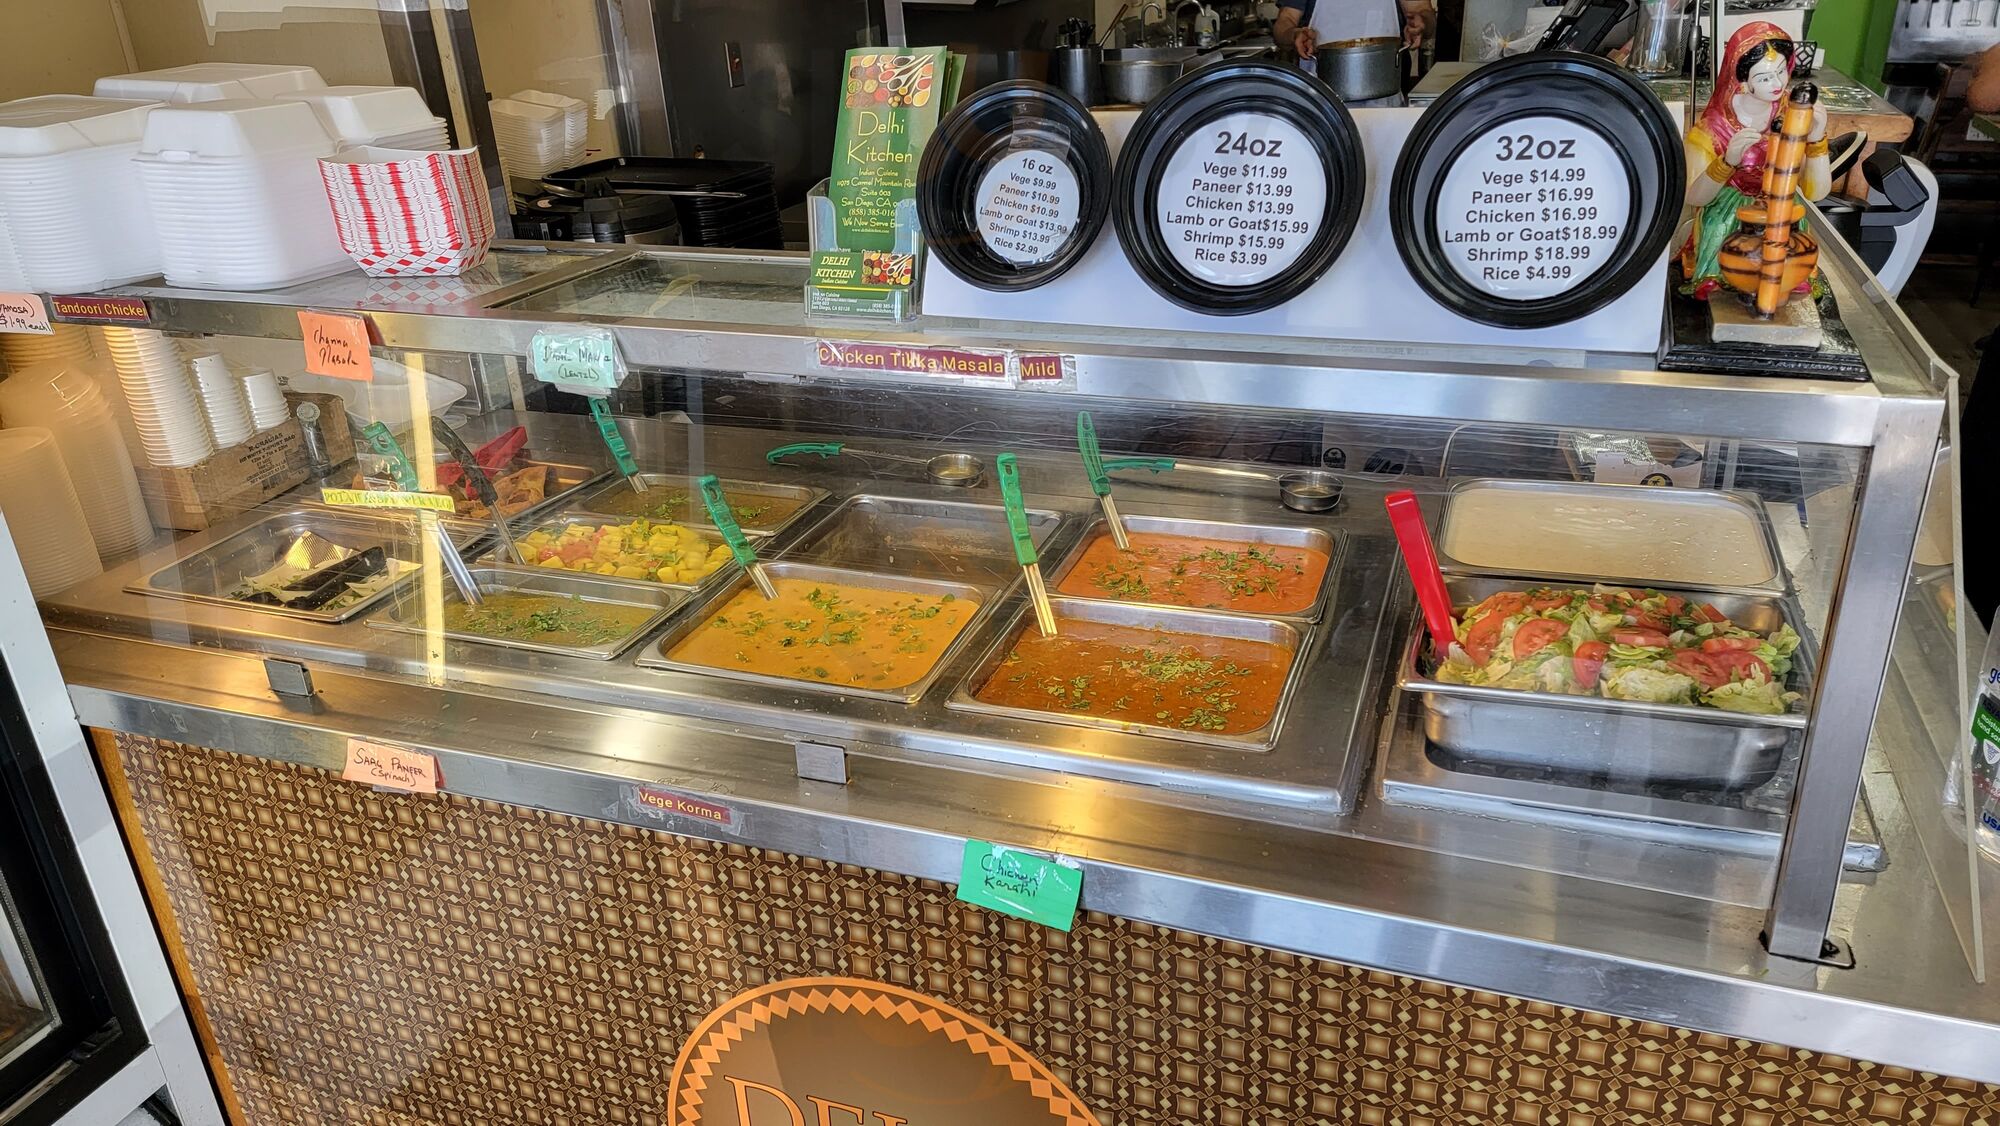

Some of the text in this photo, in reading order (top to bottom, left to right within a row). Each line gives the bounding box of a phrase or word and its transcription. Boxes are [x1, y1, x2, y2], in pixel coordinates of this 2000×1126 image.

[858, 111, 906, 136] Delhi
[847, 139, 913, 165] Kitchen
[1214, 131, 1283, 158] 24oz
[1495, 134, 1577, 162] 32oz
[1022, 158, 1054, 175] 16 oz
[1203, 161, 1288, 180] Vege $11.99
[874, 178, 903, 188] Mountain
[1010, 172, 1057, 190] Vege $9.99
[1482, 167, 1586, 188] Vege $14.99
[999, 183, 1061, 205] Paneer $10.99
[1192, 178, 1293, 198] Paneer $13.99
[1472, 187, 1595, 205] Paneer $16.99
[841, 197, 854, 208] San
[876, 197, 892, 208] CA
[993, 196, 1060, 219] Chicken $10.99
[1185, 195, 1294, 215] Chicken $13.99
[849, 208, 866, 218] (858)
[979, 206, 1068, 234] Lamb or Goat $13.99
[1166, 211, 1205, 226] Lamb
[1208, 217, 1225, 228] or
[1465, 206, 1598, 224] Chicken $16.99
[989, 222, 1051, 244] Shrimp $13.99
[1183, 230, 1285, 250] Shrimp $15.99
[1444, 229, 1491, 244] Lamb
[1496, 231, 1515, 243] or
[994, 237, 1039, 255] Rice $2.99
[1467, 245, 1591, 264] Shrimp $18.99
[820, 256, 851, 267] DELHI
[1194, 248, 1268, 266] Rice $3.99
[815, 268, 857, 280] KITCHEN
[1483, 265, 1572, 281] Rice $4.99
[53, 301, 102, 315] Tandoori
[890, 350, 937, 371] Tikka
[942, 354, 1004, 374] Masala
[1020, 354, 1057, 376] Mild
[640, 792, 722, 820] Vege Korma
